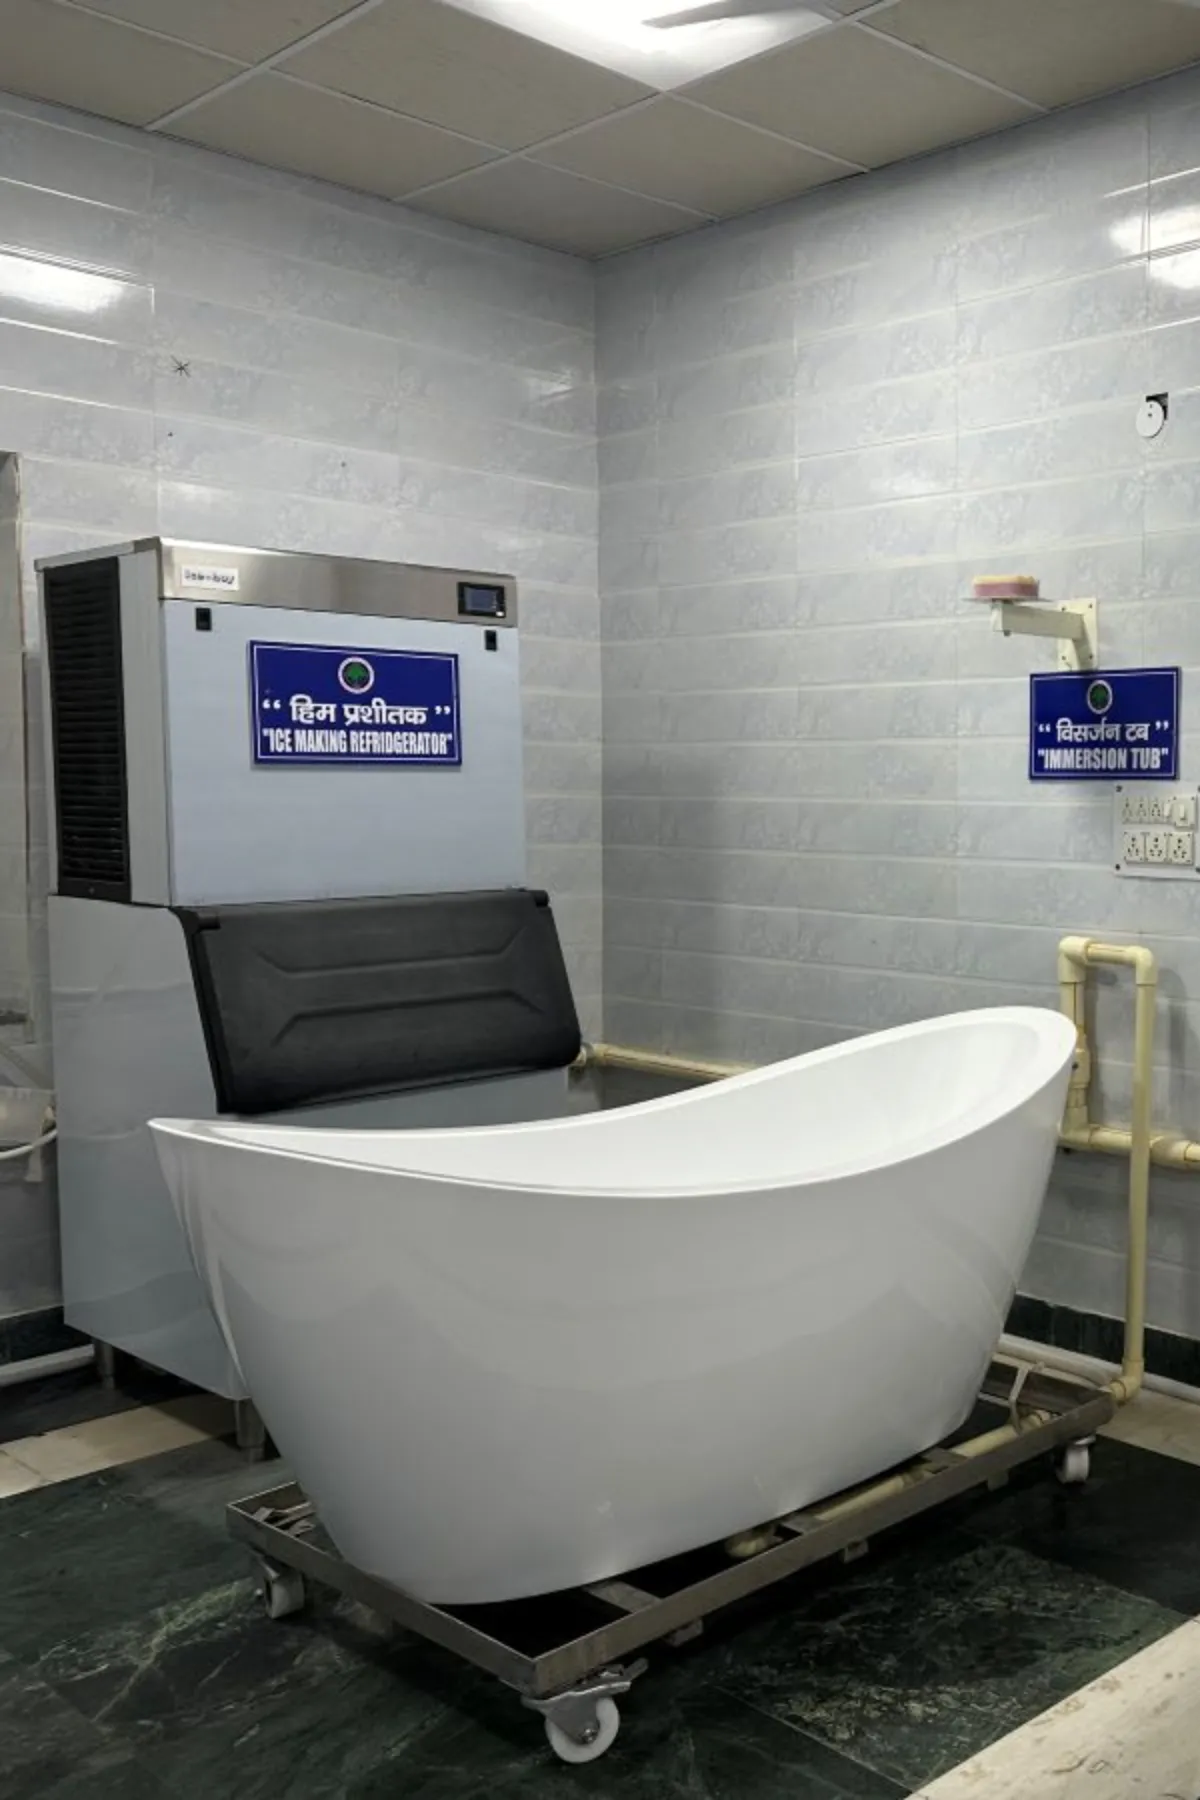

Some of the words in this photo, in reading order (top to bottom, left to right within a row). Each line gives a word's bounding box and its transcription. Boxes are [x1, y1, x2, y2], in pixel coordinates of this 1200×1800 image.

[290, 693, 336, 724] हिम
[342, 697, 428, 726] प्रशीतक
[294, 729, 348, 753] MAKING
[1056, 716, 1122, 743] विसर्जन
[1125, 722, 1151, 741] टब
